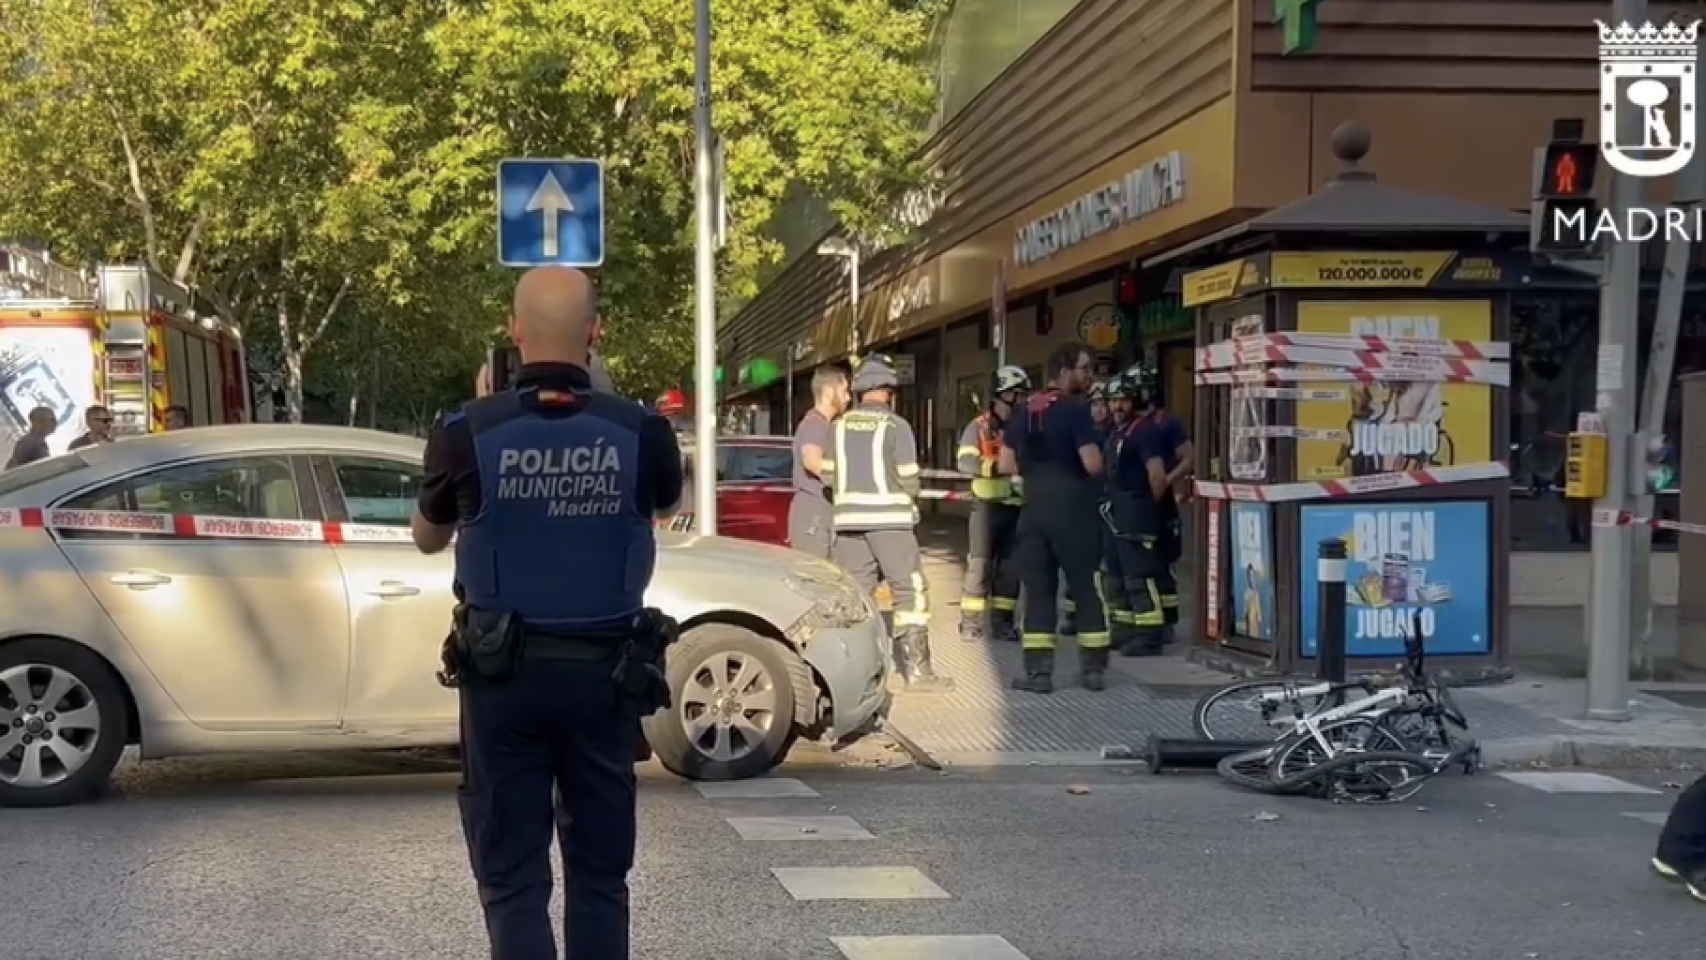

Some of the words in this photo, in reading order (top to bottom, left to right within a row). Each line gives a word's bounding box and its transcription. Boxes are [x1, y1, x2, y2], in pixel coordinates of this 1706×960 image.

[1318, 266, 1411, 281] 120.000.000
[1350, 422, 1438, 456] JUGADO
[498, 436, 621, 475] POLICÍA
[498, 474, 622, 500] MUNICIPAL
[546, 499, 621, 517] Madrid
[1353, 510, 1435, 562] BIEN
